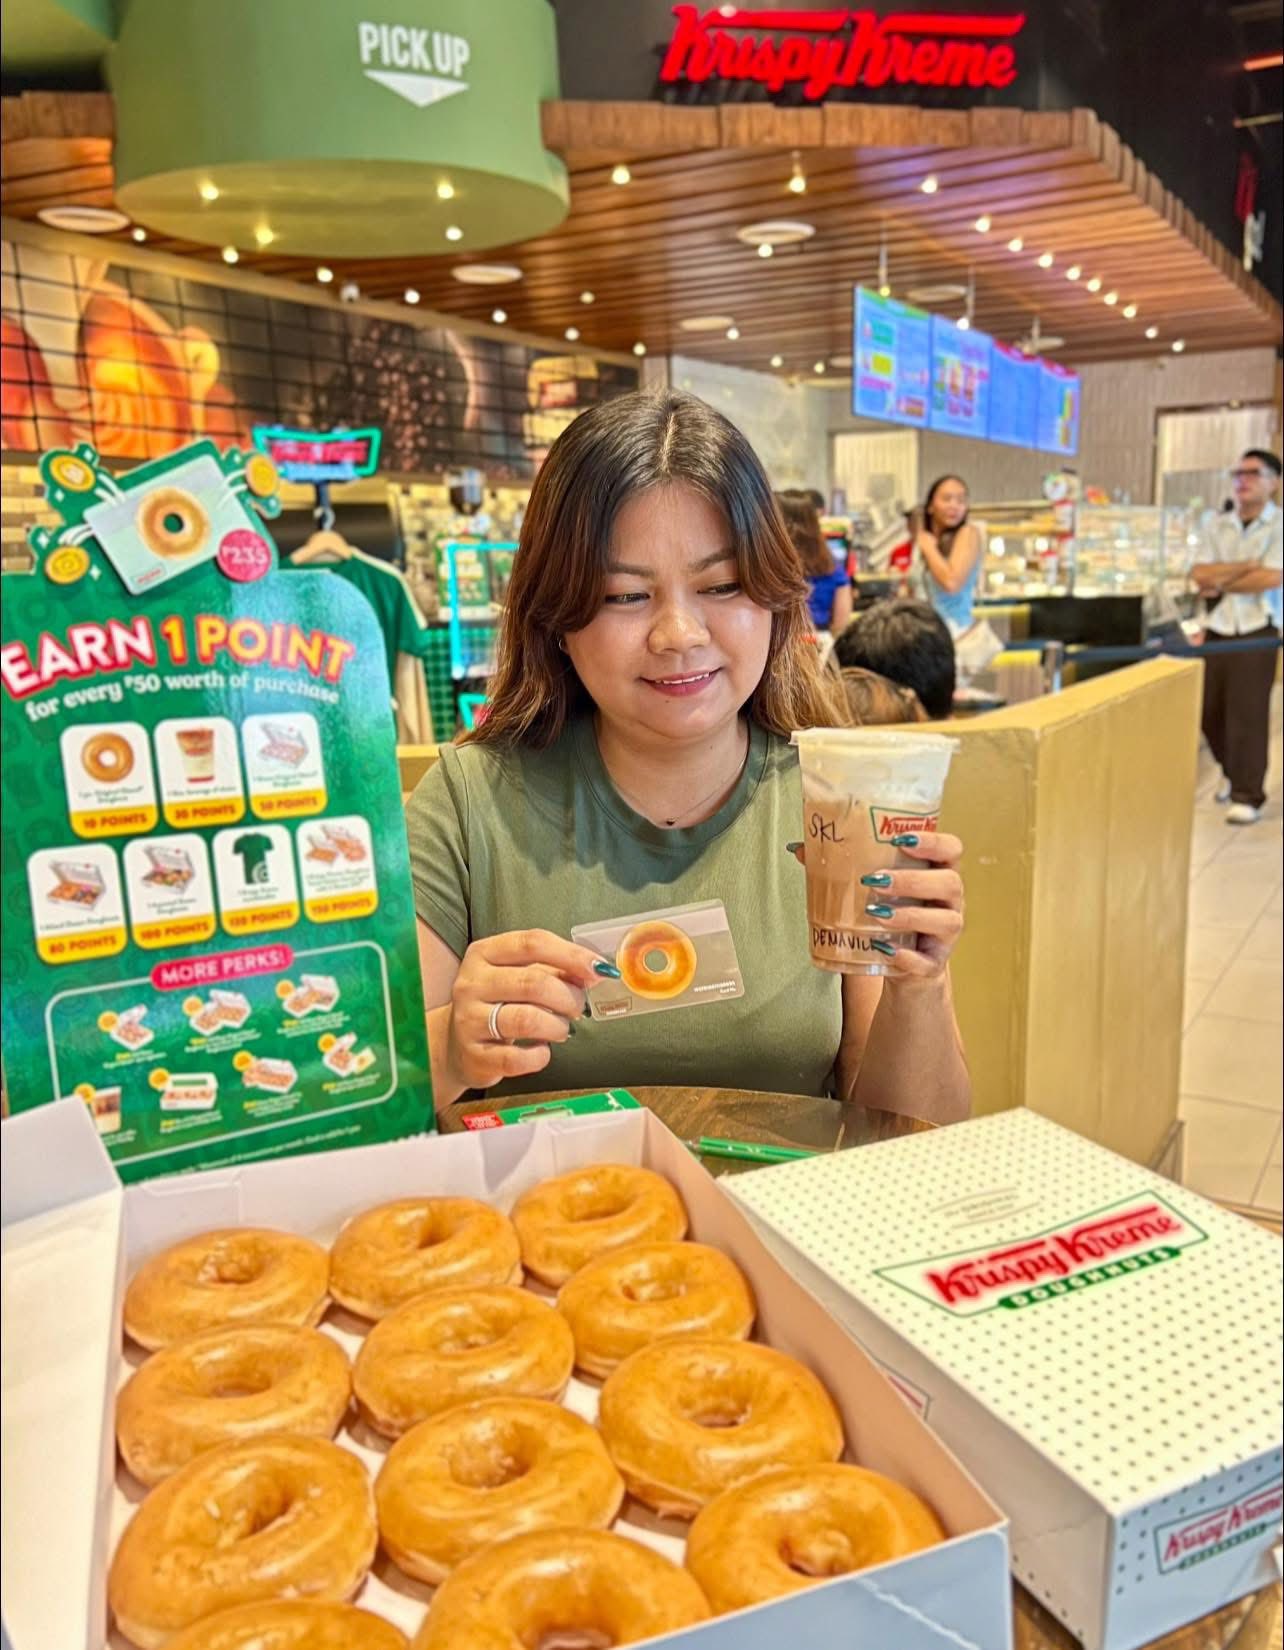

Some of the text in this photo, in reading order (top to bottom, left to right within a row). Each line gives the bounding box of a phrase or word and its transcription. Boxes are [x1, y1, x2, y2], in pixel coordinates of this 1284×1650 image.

[359, 20, 470, 78] PICK UP
[660, 4, 1026, 100] Krispy Kreme
[1, 613, 356, 700] EARN 1 POINT
[25, 694, 60, 721] for
[63, 678, 123, 708] every
[164, 670, 225, 690] worth
[232, 672, 250, 689] of
[254, 674, 340, 704] purchase
[192, 804, 237, 817] POINTS
[277, 797, 319, 809] POINTS
[101, 813, 148, 827] POINTS
[808, 812, 845, 843] SKL
[332, 898, 372, 911] POINTS
[251, 909, 293, 923] POINTS
[164, 922, 209, 936] POINTS
[69, 936, 117, 950] POINTS
[160, 949, 287, 984] MORE PERKS!
[925, 1239, 1069, 1306] Krispy
[1054, 1204, 1183, 1263] Kreme
